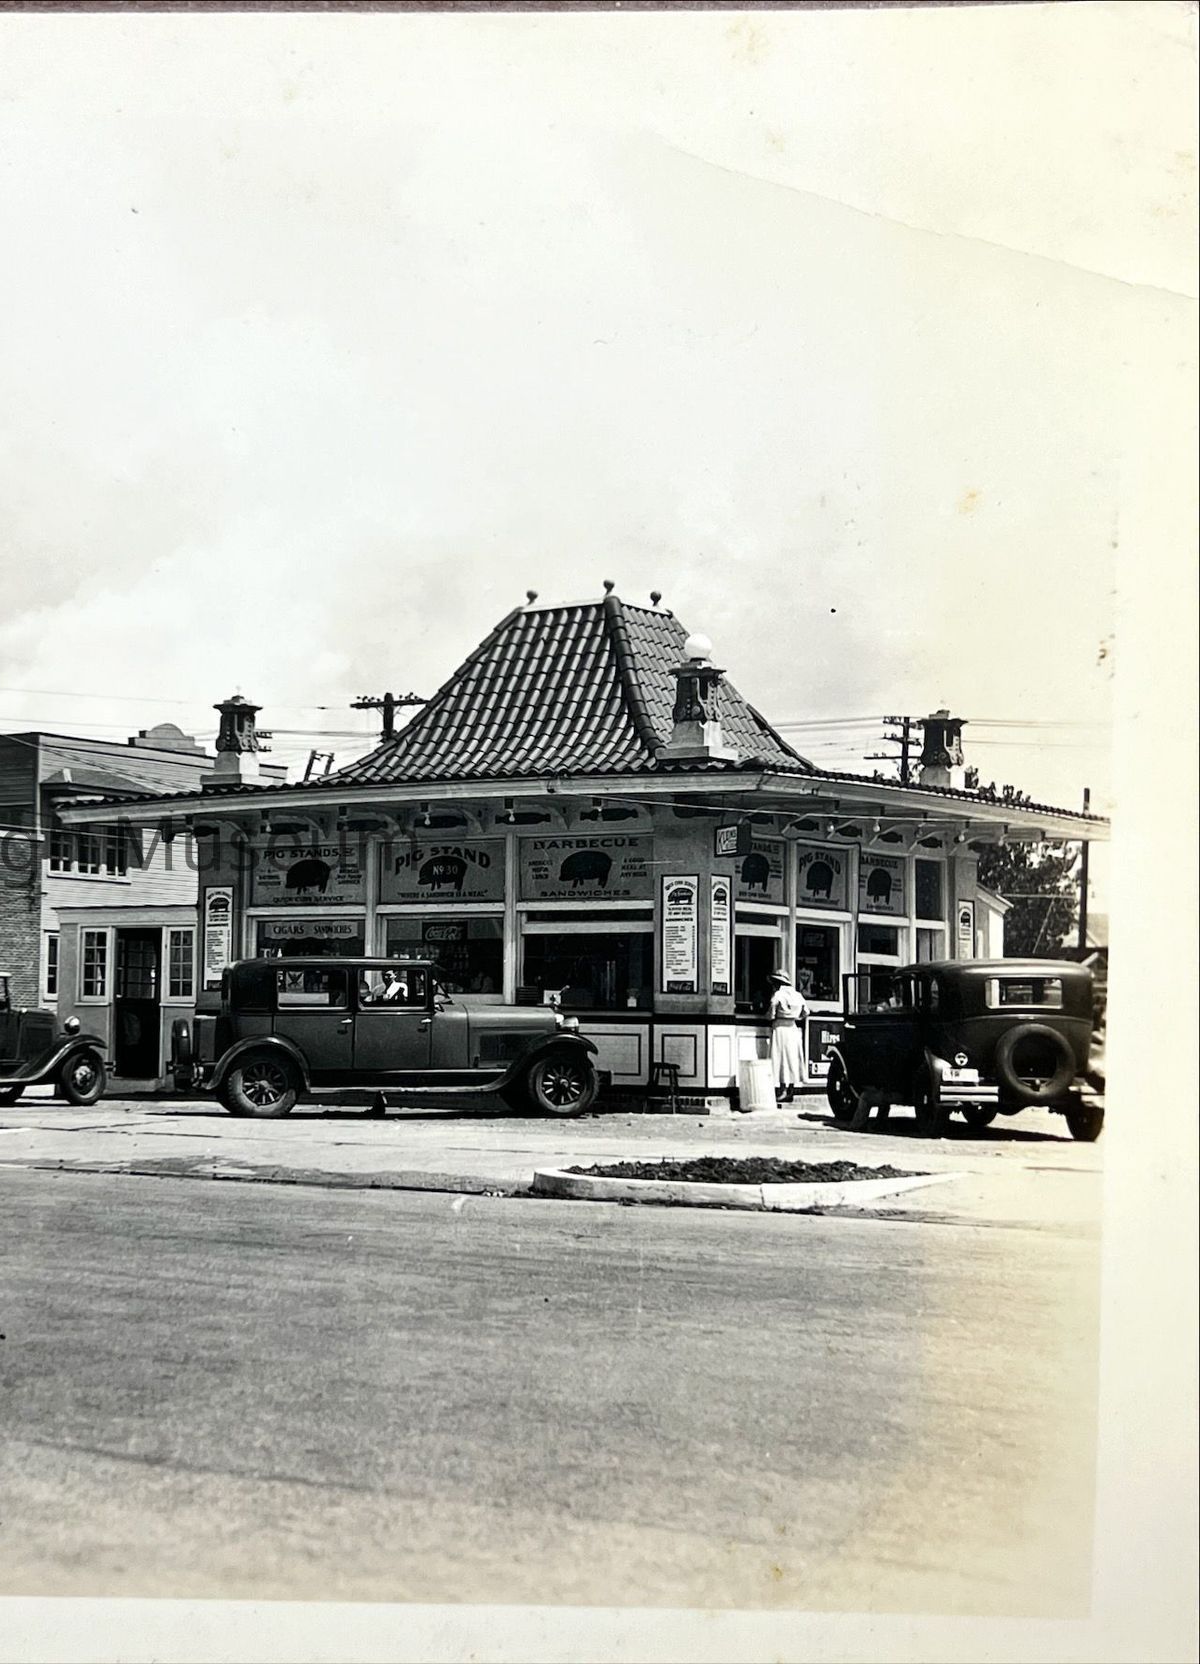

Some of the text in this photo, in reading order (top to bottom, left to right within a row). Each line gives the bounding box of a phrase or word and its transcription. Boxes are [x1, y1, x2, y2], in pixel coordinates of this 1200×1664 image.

[533, 838, 639, 850] BARBECUE
[395, 846, 491, 876] PIG STAND
[815, 852, 841, 875] STAND
[541, 889, 631, 897] SANDWICHES
[273, 925, 305, 934] CIGARS
